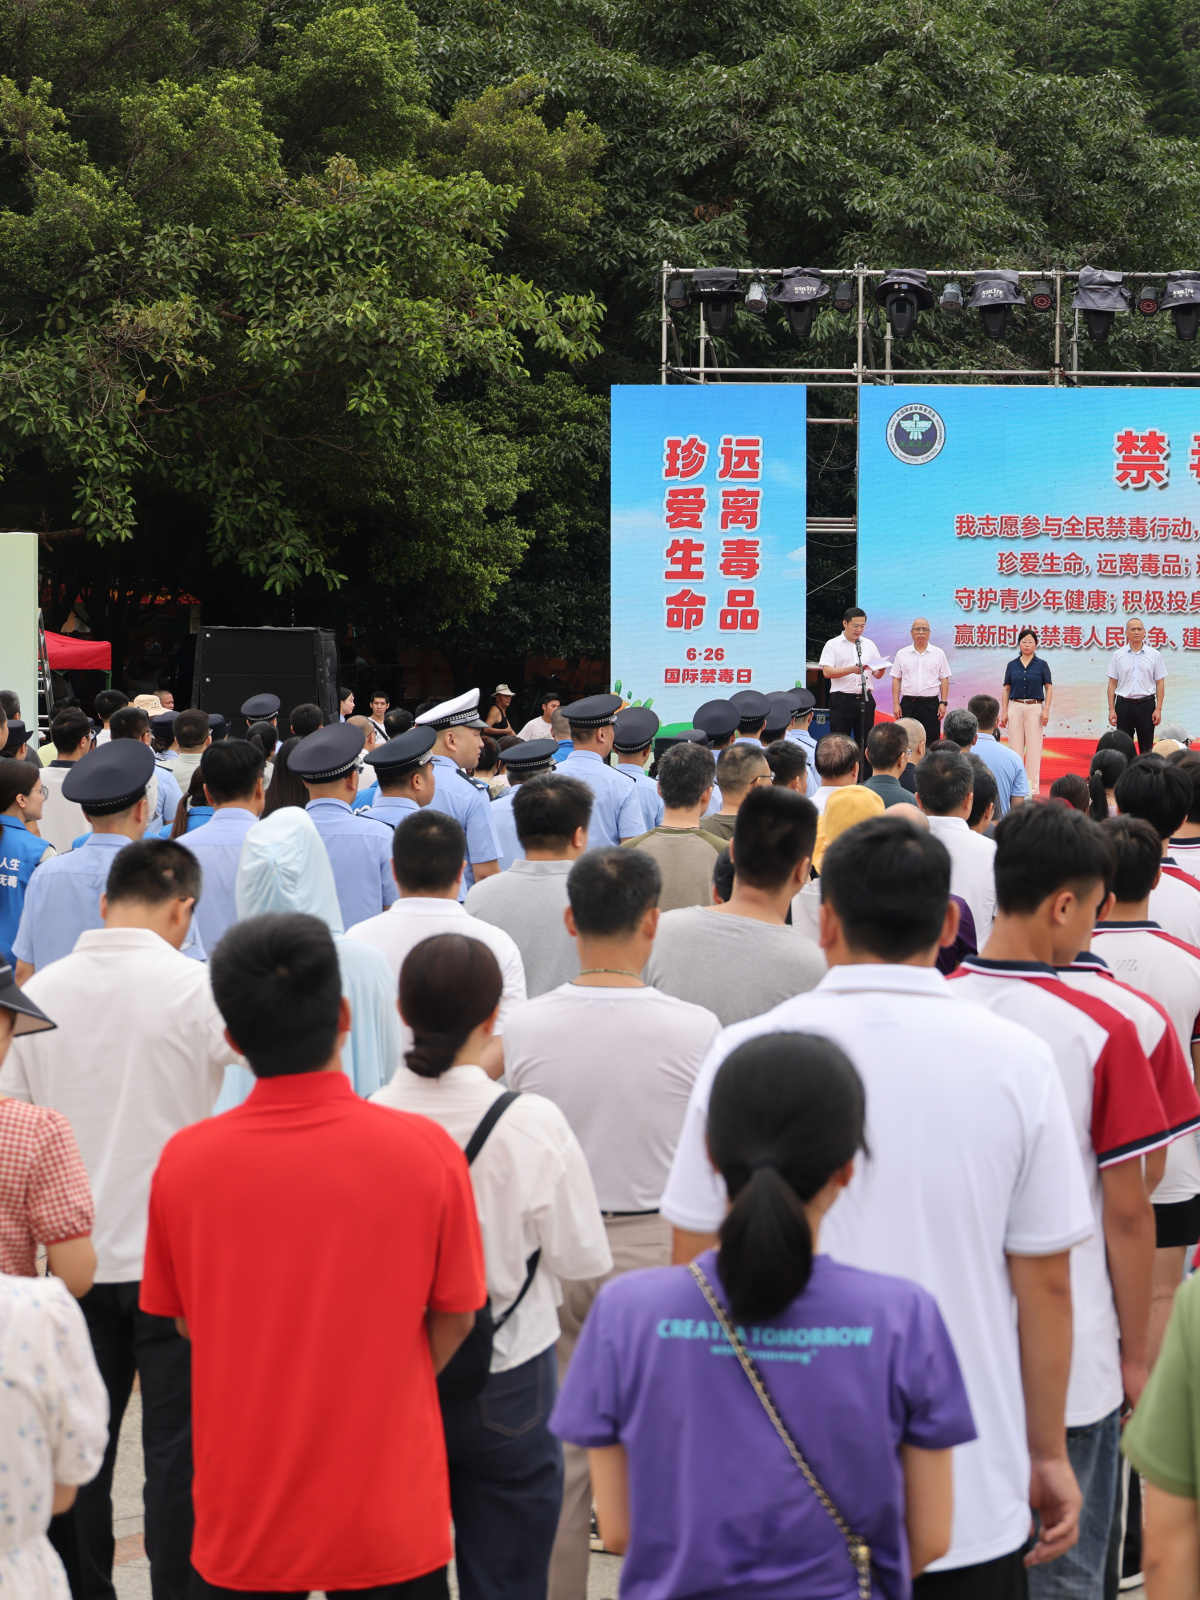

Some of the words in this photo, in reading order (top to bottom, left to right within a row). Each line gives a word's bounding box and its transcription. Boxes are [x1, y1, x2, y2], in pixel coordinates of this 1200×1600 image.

[664, 436, 708, 631] 珍爱生命
[718, 436, 761, 631] 远离毒品
[664, 668, 752, 684] 国际禁毒日
[750, 1326, 874, 1348] TOMORROW
